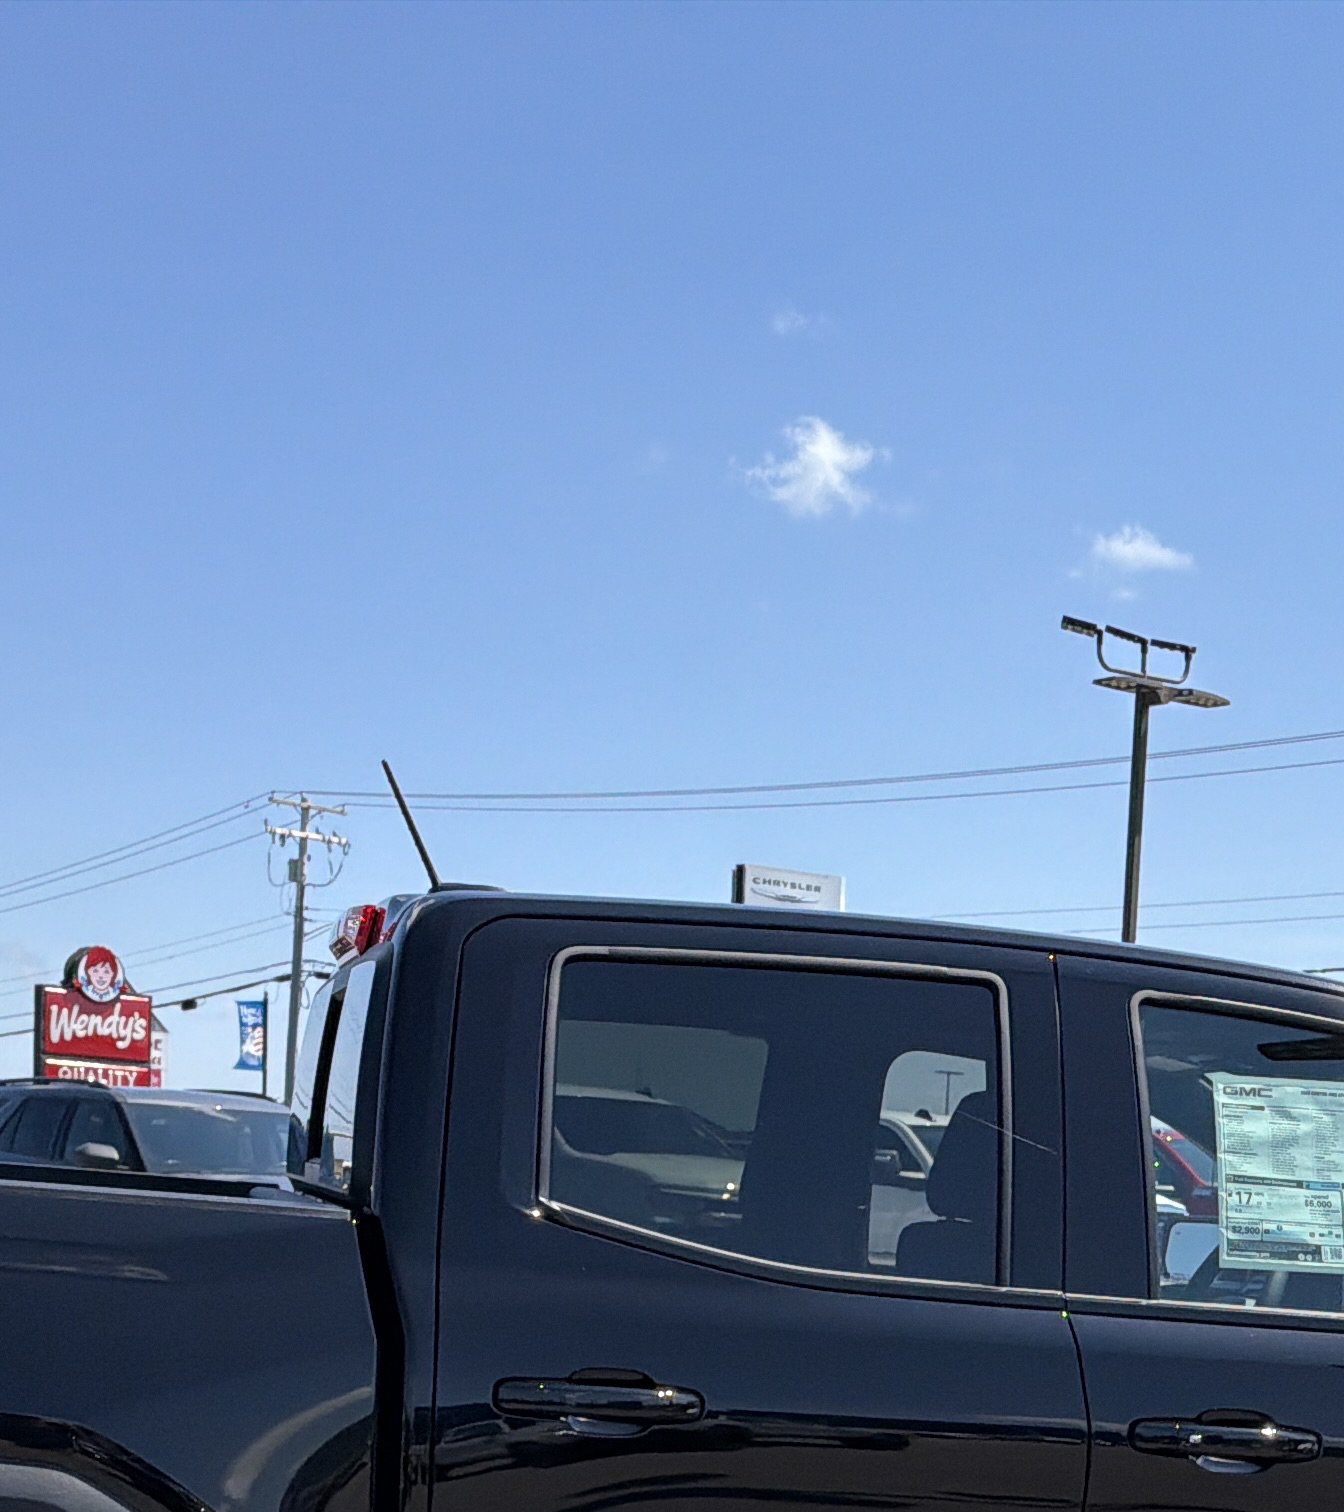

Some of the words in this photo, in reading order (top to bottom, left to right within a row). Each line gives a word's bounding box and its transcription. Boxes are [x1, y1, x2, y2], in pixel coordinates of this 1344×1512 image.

[752, 877, 822, 893] CHRYSLER
[50, 1002, 147, 1049] Wendy's
[58, 1066, 138, 1087] QUALITY
[1223, 1086, 1273, 1098] GMC
[1235, 1191, 1253, 1205] 17
